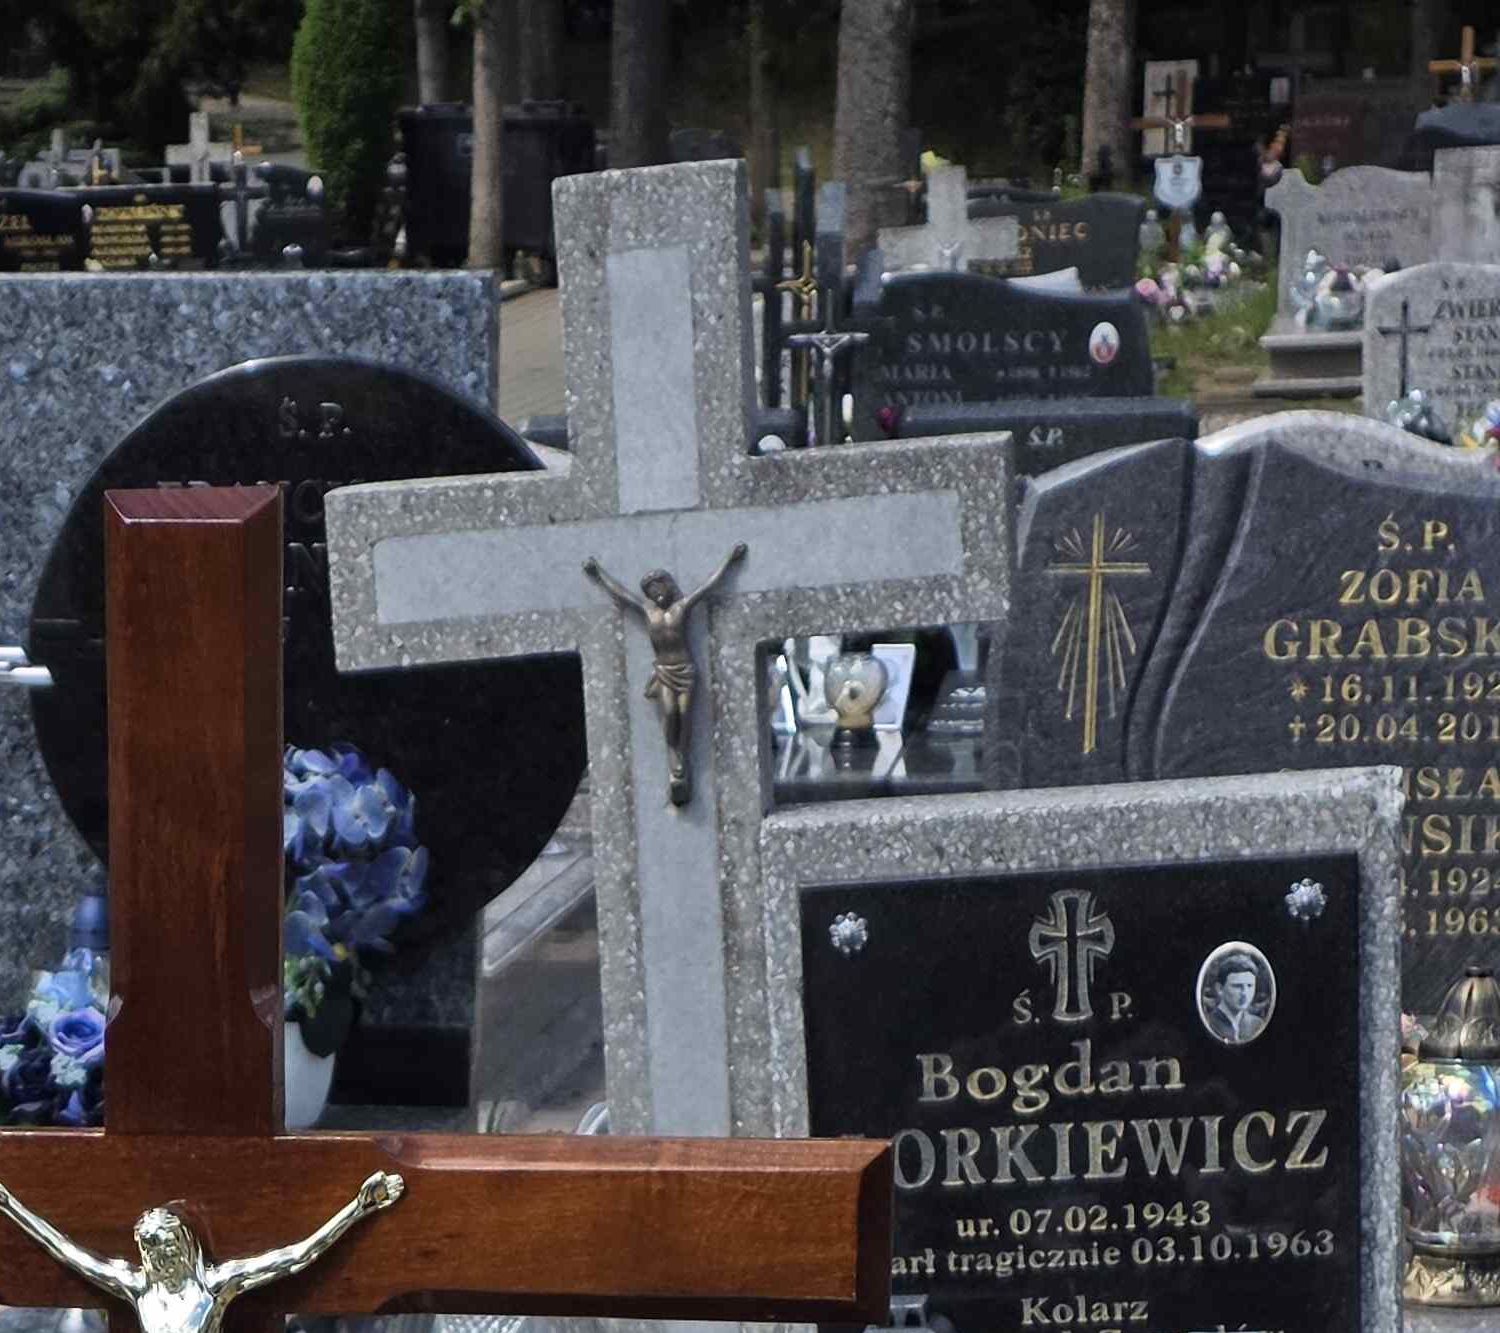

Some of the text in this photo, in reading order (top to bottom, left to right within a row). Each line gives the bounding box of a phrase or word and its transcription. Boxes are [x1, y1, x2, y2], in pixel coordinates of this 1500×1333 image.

[907, 330, 1068, 353] SMOLSCY
[1339, 567, 1486, 605] ZOFIA
[916, 1039, 1187, 1112] Bogdan
[893, 1107, 1329, 1192] ORKIEWICZ
[956, 1200, 1213, 1239] ur. 07.02.1943
[891, 1229, 1336, 1277] arł tragicznie 03.10.1963
[1020, 1294, 1150, 1326] Kolarz
